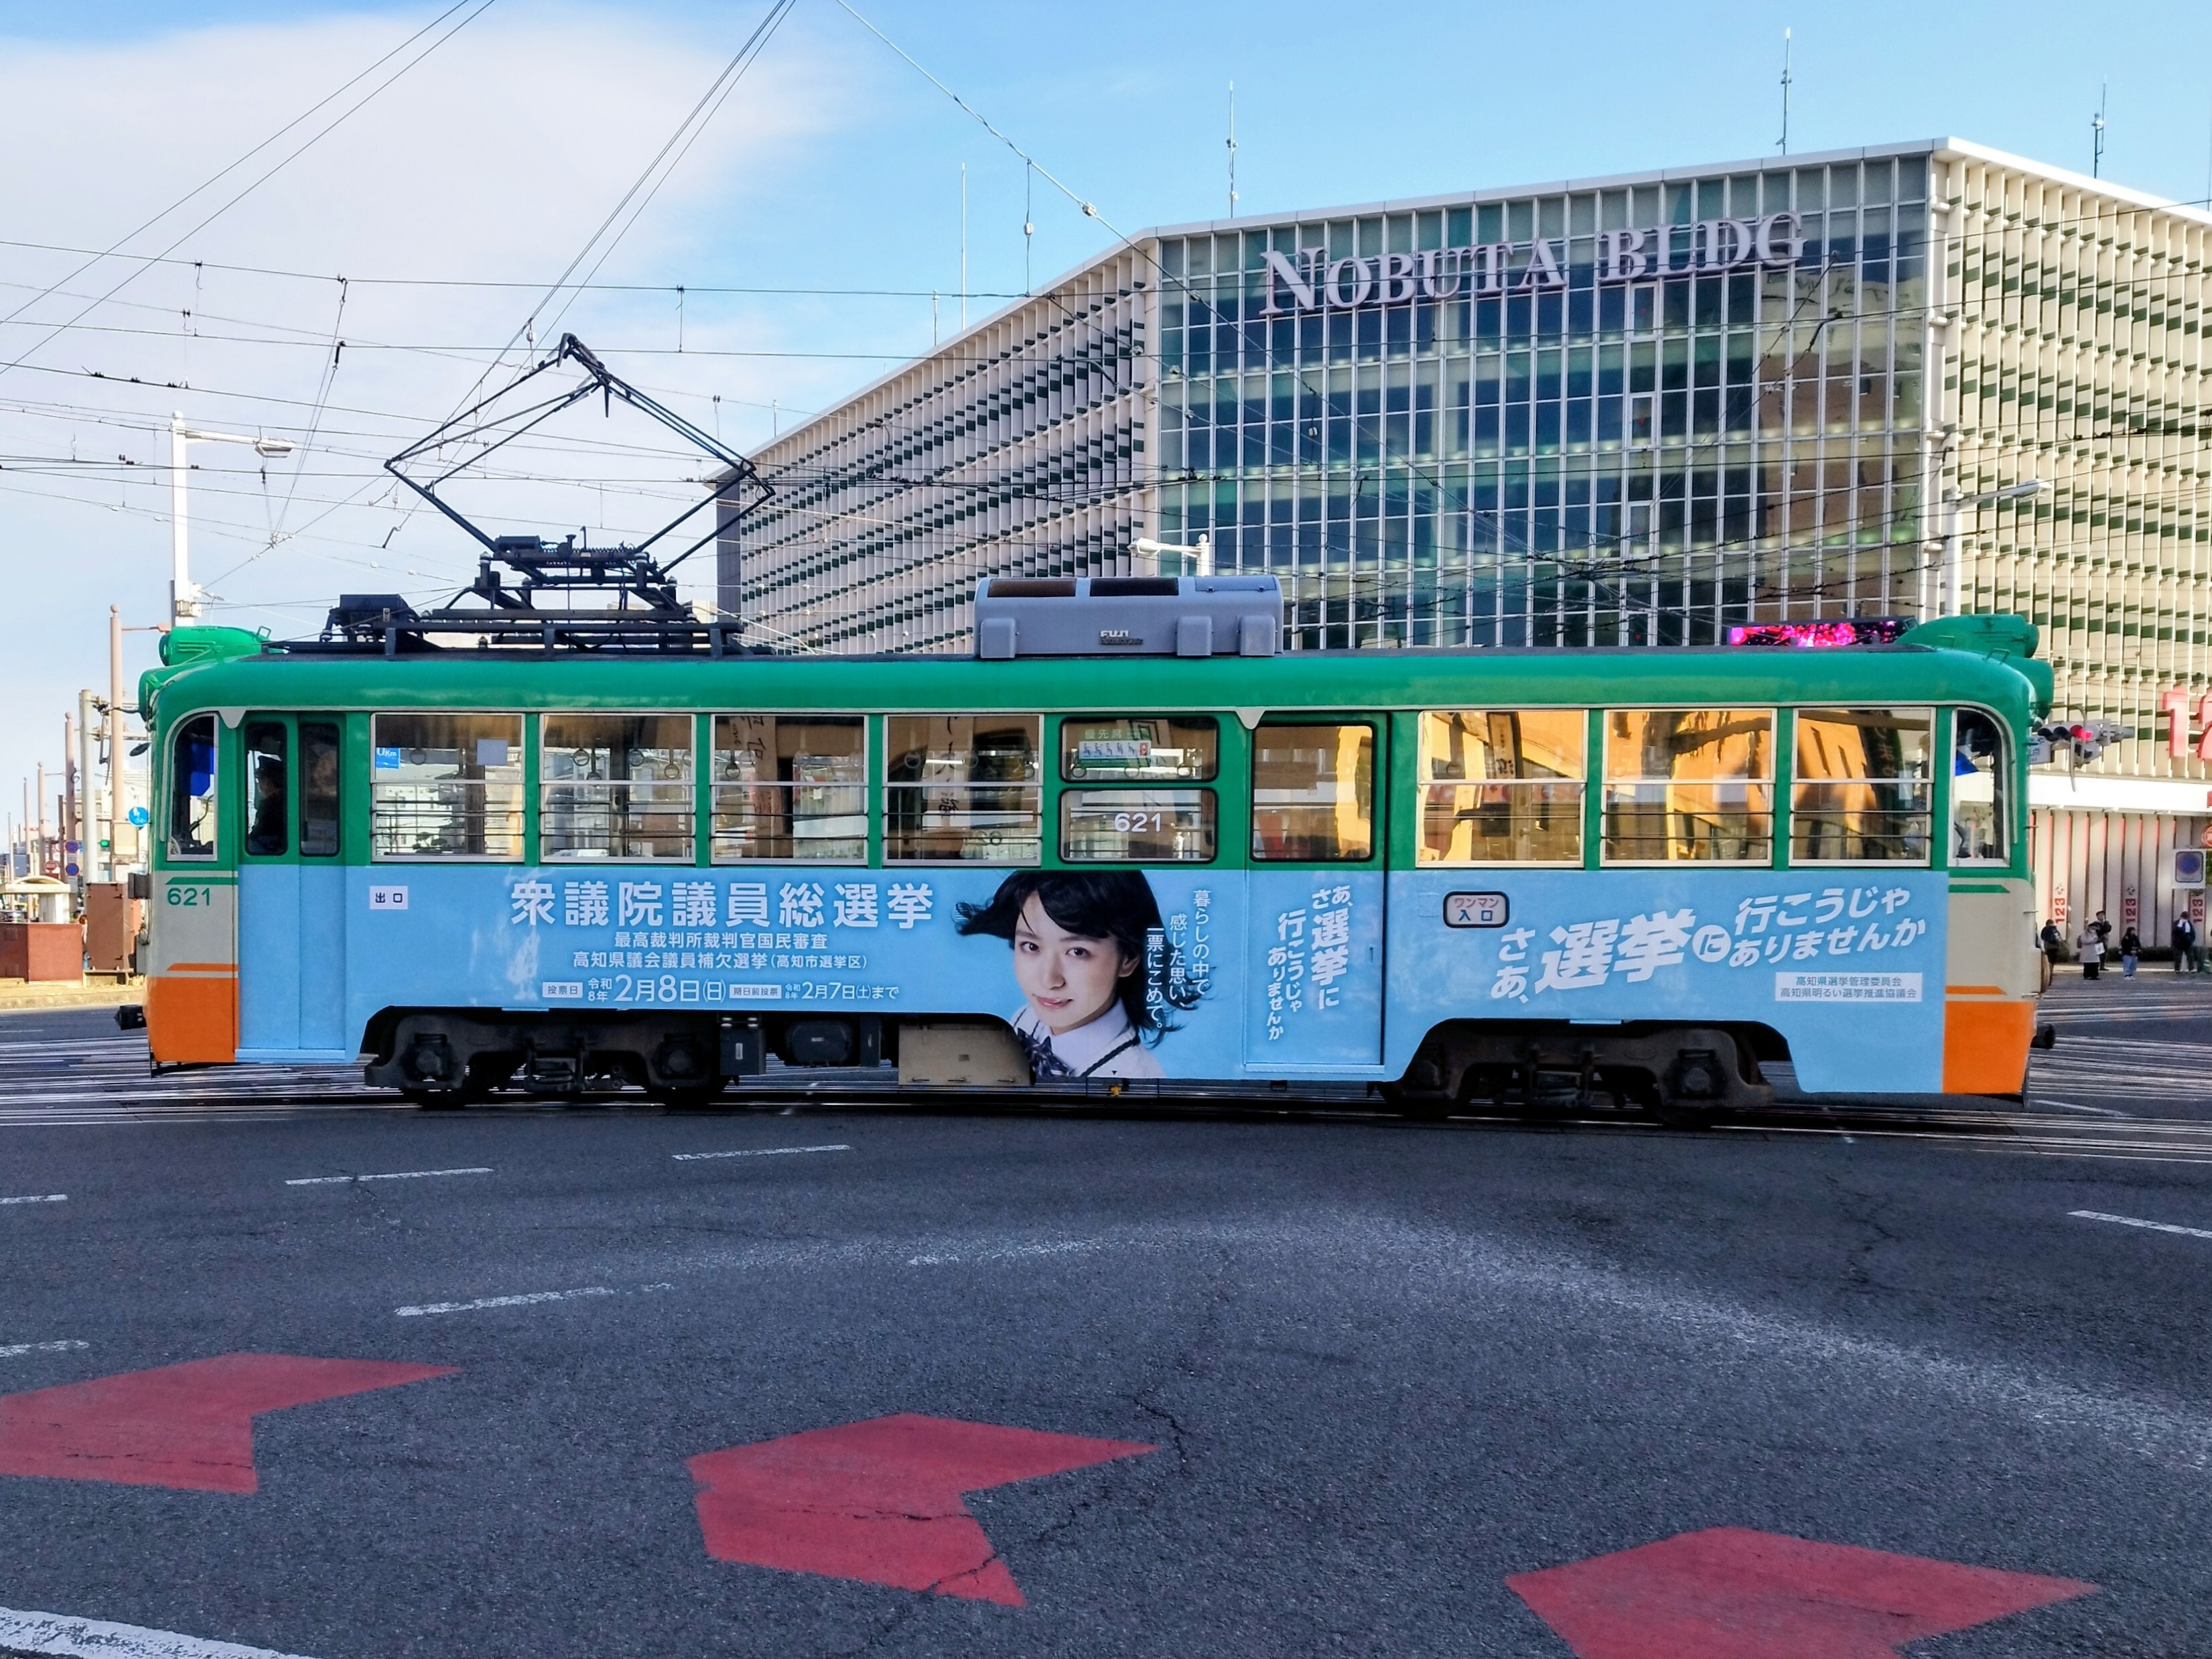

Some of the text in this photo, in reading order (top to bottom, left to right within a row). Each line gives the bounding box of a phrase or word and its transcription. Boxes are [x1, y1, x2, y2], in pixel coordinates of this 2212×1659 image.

[1259, 212, 1811, 316] NOBUTA BLDG
[1101, 630, 1129, 638] FUJI
[1114, 812, 1162, 832] 621
[167, 888, 210, 906] 621
[375, 892, 403, 903] 出口
[510, 880, 933, 929] 衆議院議員総選挙
[1454, 898, 1499, 908] ワンマン
[1458, 909, 1493, 921] 入口
[1734, 886, 1910, 935] 行こうじゃ
[2055, 898, 2065, 923] 123
[2126, 899, 2136, 923] 123
[2192, 899, 2203, 923] 123
[614, 932, 828, 949] 最高裁判所裁判官国民審査
[1192, 890, 1212, 996] 暮らしの中で
[1728, 918, 1925, 968] ありませんか
[1278, 909, 1307, 1012] 行こうじゃ
[588, 978, 612, 990] 令和
[1146, 928, 1165, 1028] 一票にこめて。
[1796, 976, 1902, 987] 高知県選挙管理委員会
[547, 986, 578, 995] 投票日
[588, 991, 609, 1001] 8年
[733, 987, 778, 996] 期日前投票
[785, 984, 801, 992] 令和
[1267, 947, 1290, 1040] ありませんか
[1781, 988, 1917, 998] 高知県明るい選挙推進協議会
